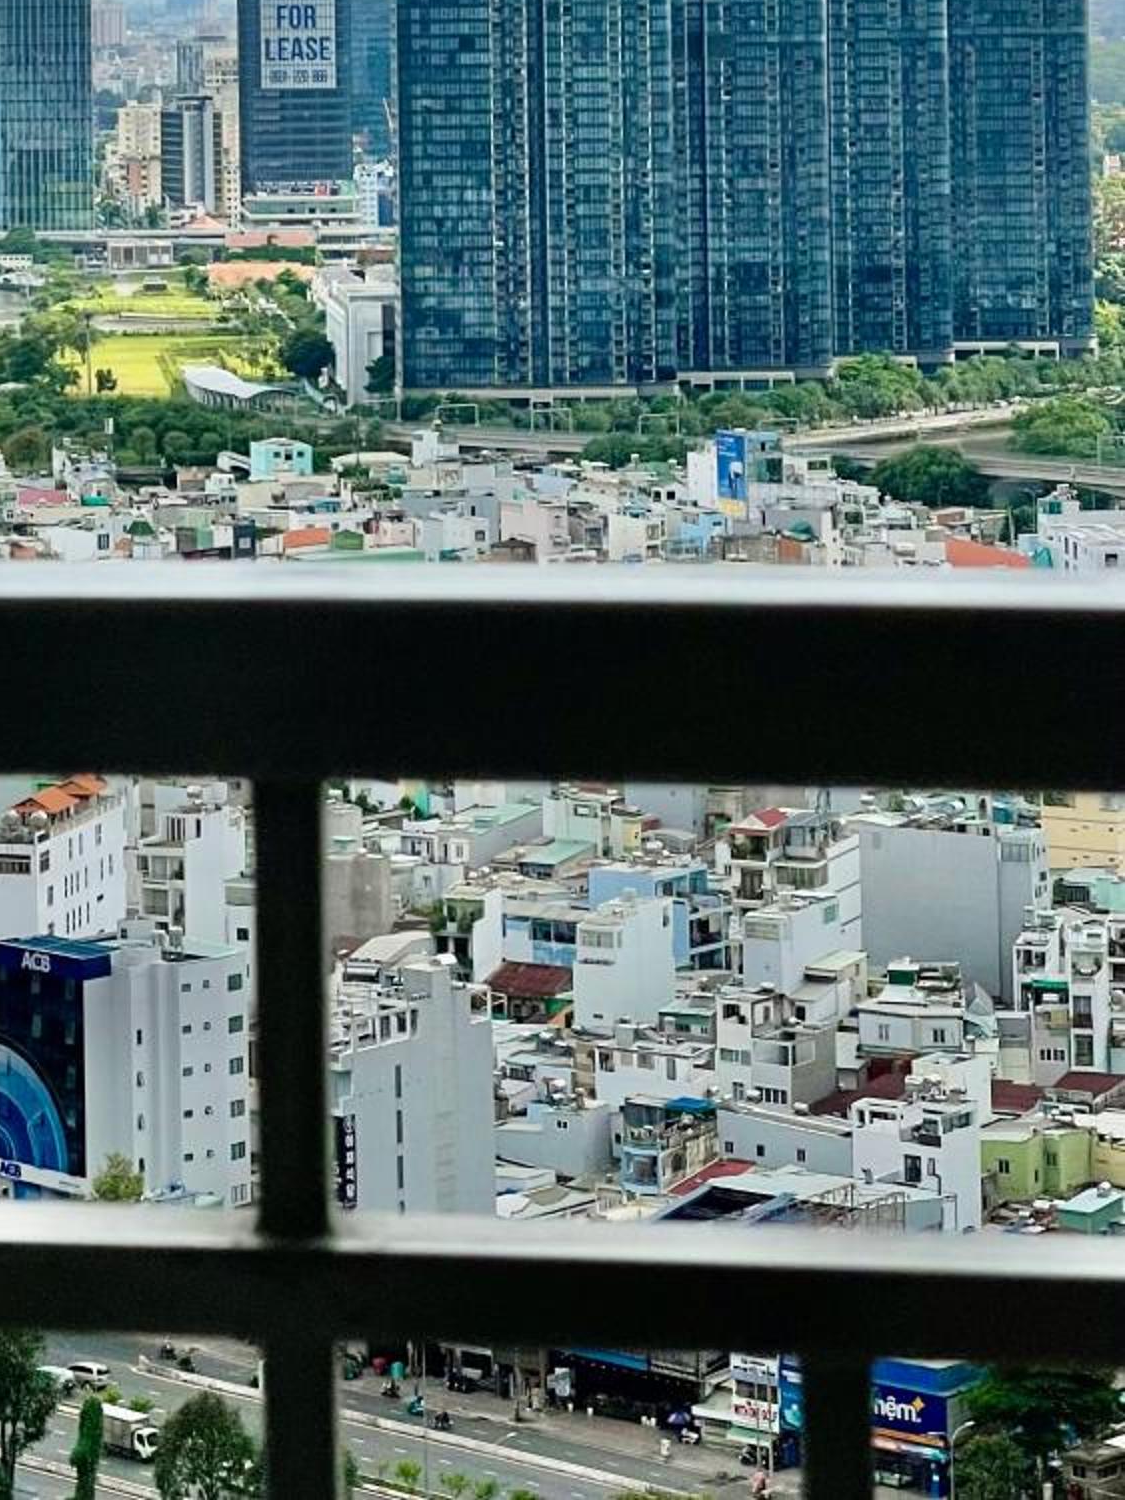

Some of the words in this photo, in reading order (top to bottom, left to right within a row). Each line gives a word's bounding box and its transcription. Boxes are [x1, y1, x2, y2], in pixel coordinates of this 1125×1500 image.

[276, 4, 317, 29] FOR
[263, 35, 333, 62] LEASE
[21, 951, 51, 973] ACB
